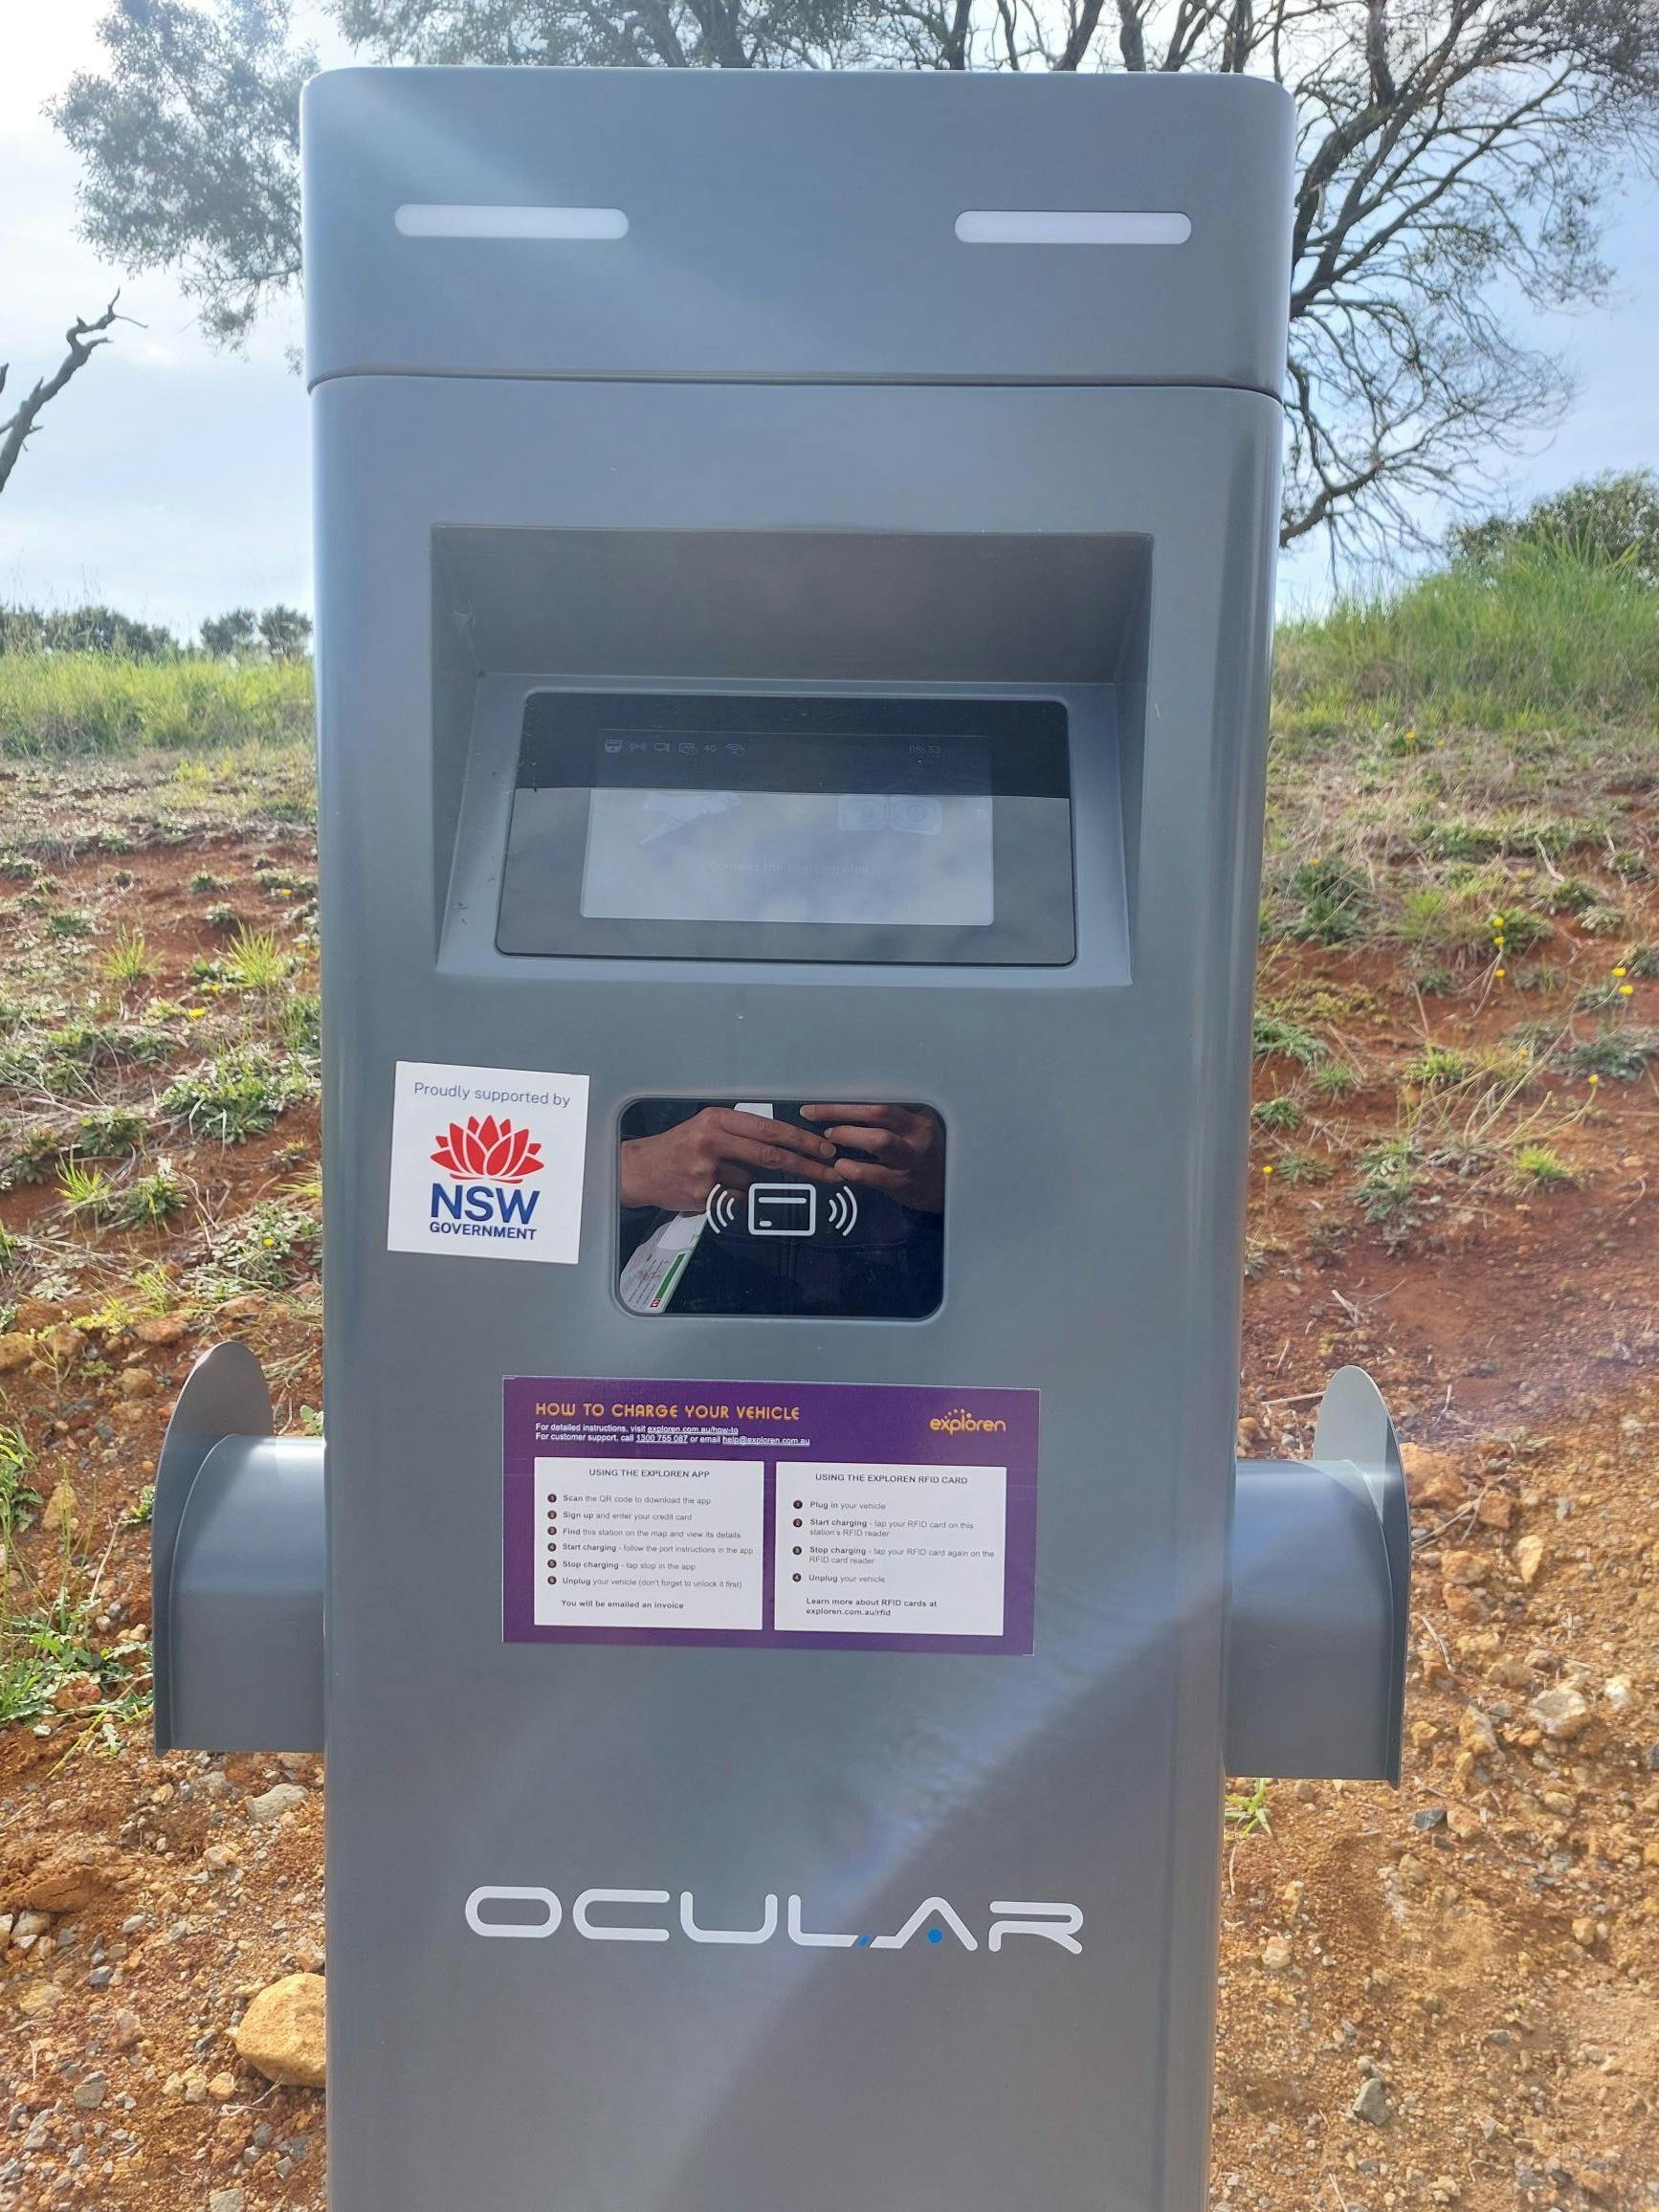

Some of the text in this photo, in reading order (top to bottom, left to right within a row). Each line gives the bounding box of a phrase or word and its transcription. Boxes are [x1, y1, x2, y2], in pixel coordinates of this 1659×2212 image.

[414, 1081, 571, 1108] Proudly supported by
[431, 1183, 541, 1225] NSW
[430, 1221, 537, 1240] GOVERNMENT
[536, 1403, 800, 1421] HOW TO CHARGE YOUR VEHICLE
[550, 1423, 581, 1431] detailed
[583, 1424, 629, 1433] instructions,
[930, 1413, 1006, 1435] exploren
[536, 1432, 549, 1441] For
[587, 1433, 619, 1443] support,
[620, 1433, 634, 1442] call
[635, 1434, 655, 1444] 1300
[657, 1435, 673, 1444] 755
[674, 1435, 688, 1444] 087
[699, 1435, 721, 1444] email
[722, 1436, 810, 1447] help@exploren.com.au
[588, 1469, 618, 1477] USING
[641, 1470, 690, 1478] EXPLOREN
[815, 1473, 845, 1482] USING
[848, 1473, 865, 1482] THE
[867, 1474, 916, 1483] EXPLOREN
[918, 1475, 940, 1484] RFID
[563, 1493, 584, 1502] Scan
[599, 1494, 612, 1503] QR
[614, 1495, 633, 1504] code
[809, 1500, 829, 1510] Plug
[859, 1501, 886, 1510] vehicle
[563, 1511, 582, 1519] Sign
[653, 1513, 675, 1521] credit
[831, 1518, 868, 1528] charging
[874, 1520, 887, 1529] tap
[907, 1520, 928, 1529] RFID
[929, 1520, 946, 1529] card
[960, 1521, 974, 1530] this
[670, 1530, 685, 1538] and
[864, 1529, 890, 1537] reader
[563, 1542, 581, 1551] Start
[583, 1543, 617, 1553] charging
[675, 1545, 716, 1554] instructions
[740, 1547, 754, 1556] app
[809, 1546, 829, 1555] Stop
[830, 1546, 867, 1556] charging
[874, 1547, 886, 1557] tap
[906, 1548, 927, 1557] RFID
[928, 1548, 946, 1557] card
[947, 1549, 969, 1558] again
[982, 1550, 995, 1559] the
[584, 1560, 619, 1570] charging
[626, 1561, 639, 1570] tap
[640, 1562, 657, 1571] stop
[681, 1563, 697, 1572] app
[850, 1557, 874, 1565] reader
[563, 1577, 591, 1586] Unplug
[611, 1578, 637, 1586] vehicle
[661, 1579, 683, 1588] forget
[694, 1580, 718, 1588] unlock
[719, 1580, 724, 1588] it
[725, 1580, 742, 1588] first)
[808, 1574, 838, 1582] Unplug
[840, 1575, 857, 1583] your
[859, 1575, 886, 1583] vehicle
[595, 1600, 606, 1608] be
[608, 1601, 640, 1609] emailed
[654, 1601, 684, 1609] invoice
[806, 1597, 830, 1605] Learn
[855, 1598, 879, 1606] about
[903, 1599, 927, 1607] cards
[806, 1607, 891, 1617] exploren.com.au/rfid
[465, 1886, 1084, 1955] OCULAR
